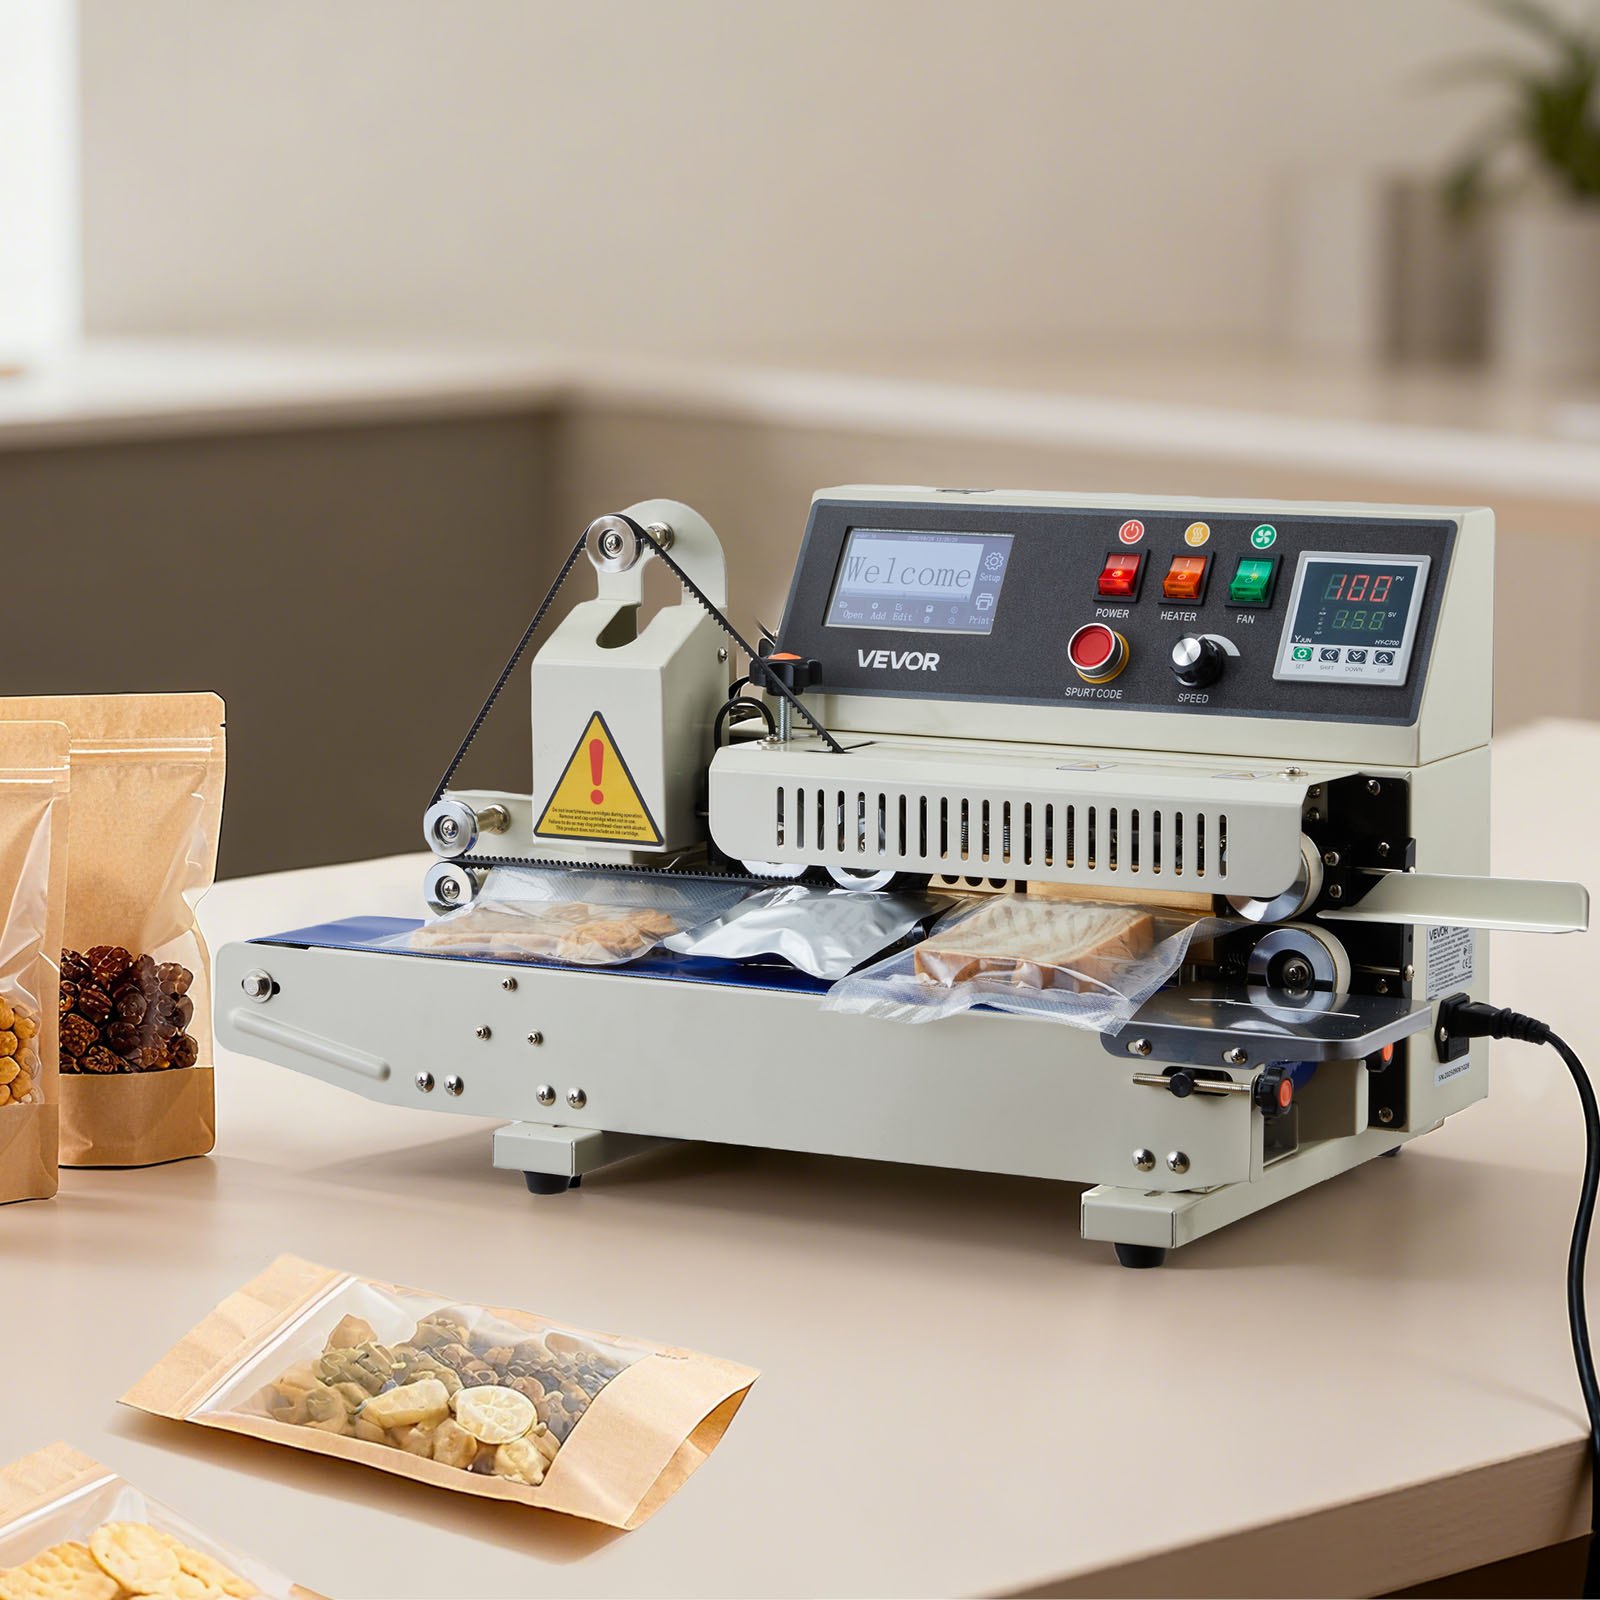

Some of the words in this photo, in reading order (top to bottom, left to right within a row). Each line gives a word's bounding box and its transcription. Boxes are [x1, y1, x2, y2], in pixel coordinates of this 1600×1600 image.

[847, 556, 971, 588] Welcome
[979, 572, 1000, 583] Setup
[1335, 574, 1392, 602] 100
[843, 610, 864, 620] Open
[870, 611, 886, 621] Add
[892, 612, 912, 622] Edit
[1095, 608, 1130, 619] POWER
[1160, 611, 1197, 622] HEATER
[1236, 614, 1255, 624] FAN
[968, 616, 989, 625] Print
[857, 649, 940, 671] VEVOR
[1065, 687, 1096, 698] SPURT
[1096, 688, 1123, 699] CODE
[1177, 693, 1209, 704] SPEED
